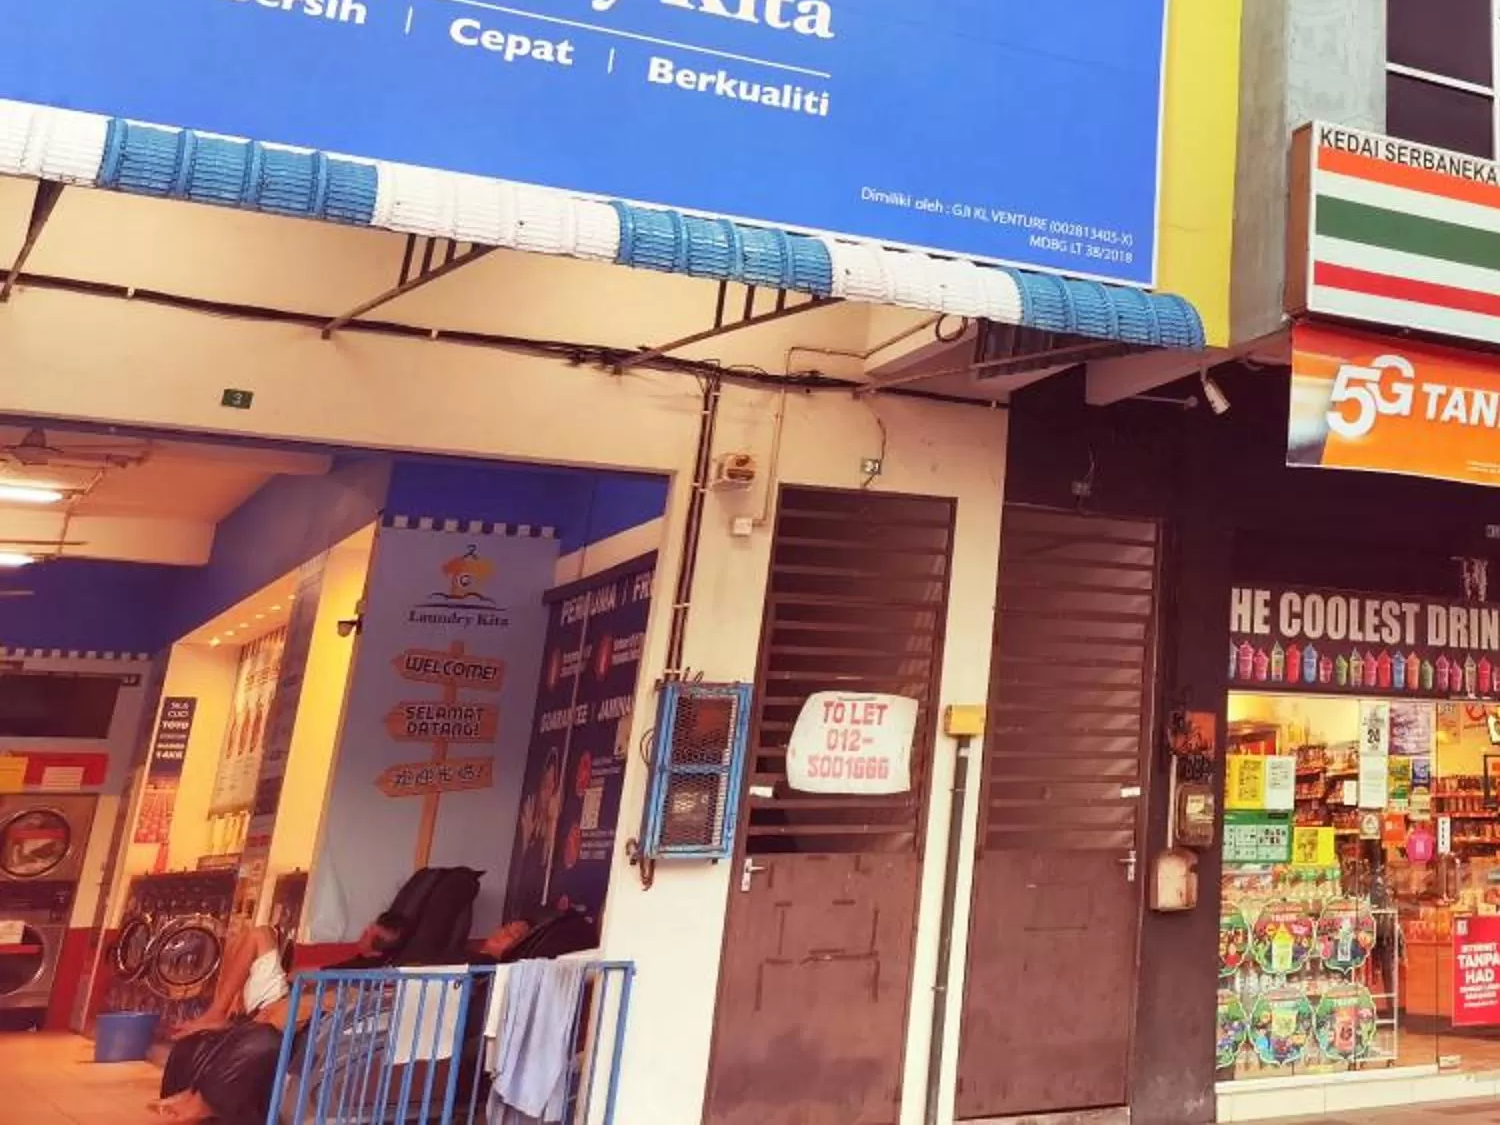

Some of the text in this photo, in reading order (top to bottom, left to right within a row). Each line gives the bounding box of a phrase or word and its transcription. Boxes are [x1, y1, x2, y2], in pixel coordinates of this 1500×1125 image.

[449, 17, 575, 66] Cepat
[647, 55, 831, 118] Berkualiti
[1319, 126, 1500, 185] KEDAI SERBANEKA
[861, 186, 912, 209] Dimiliki
[915, 197, 944, 214] oleh
[991, 209, 1047, 232] VENTURE
[1325, 353, 1416, 439] 5G
[1229, 586, 1272, 634] HE
[1279, 592, 1422, 645] COOLEST
[405, 705, 485, 722] SELAMAT
[407, 720, 479, 736] DATANG!
[823, 700, 889, 726] TO LET
[826, 727, 875, 752] 012-
[1464, 968, 1496, 984] HAD
